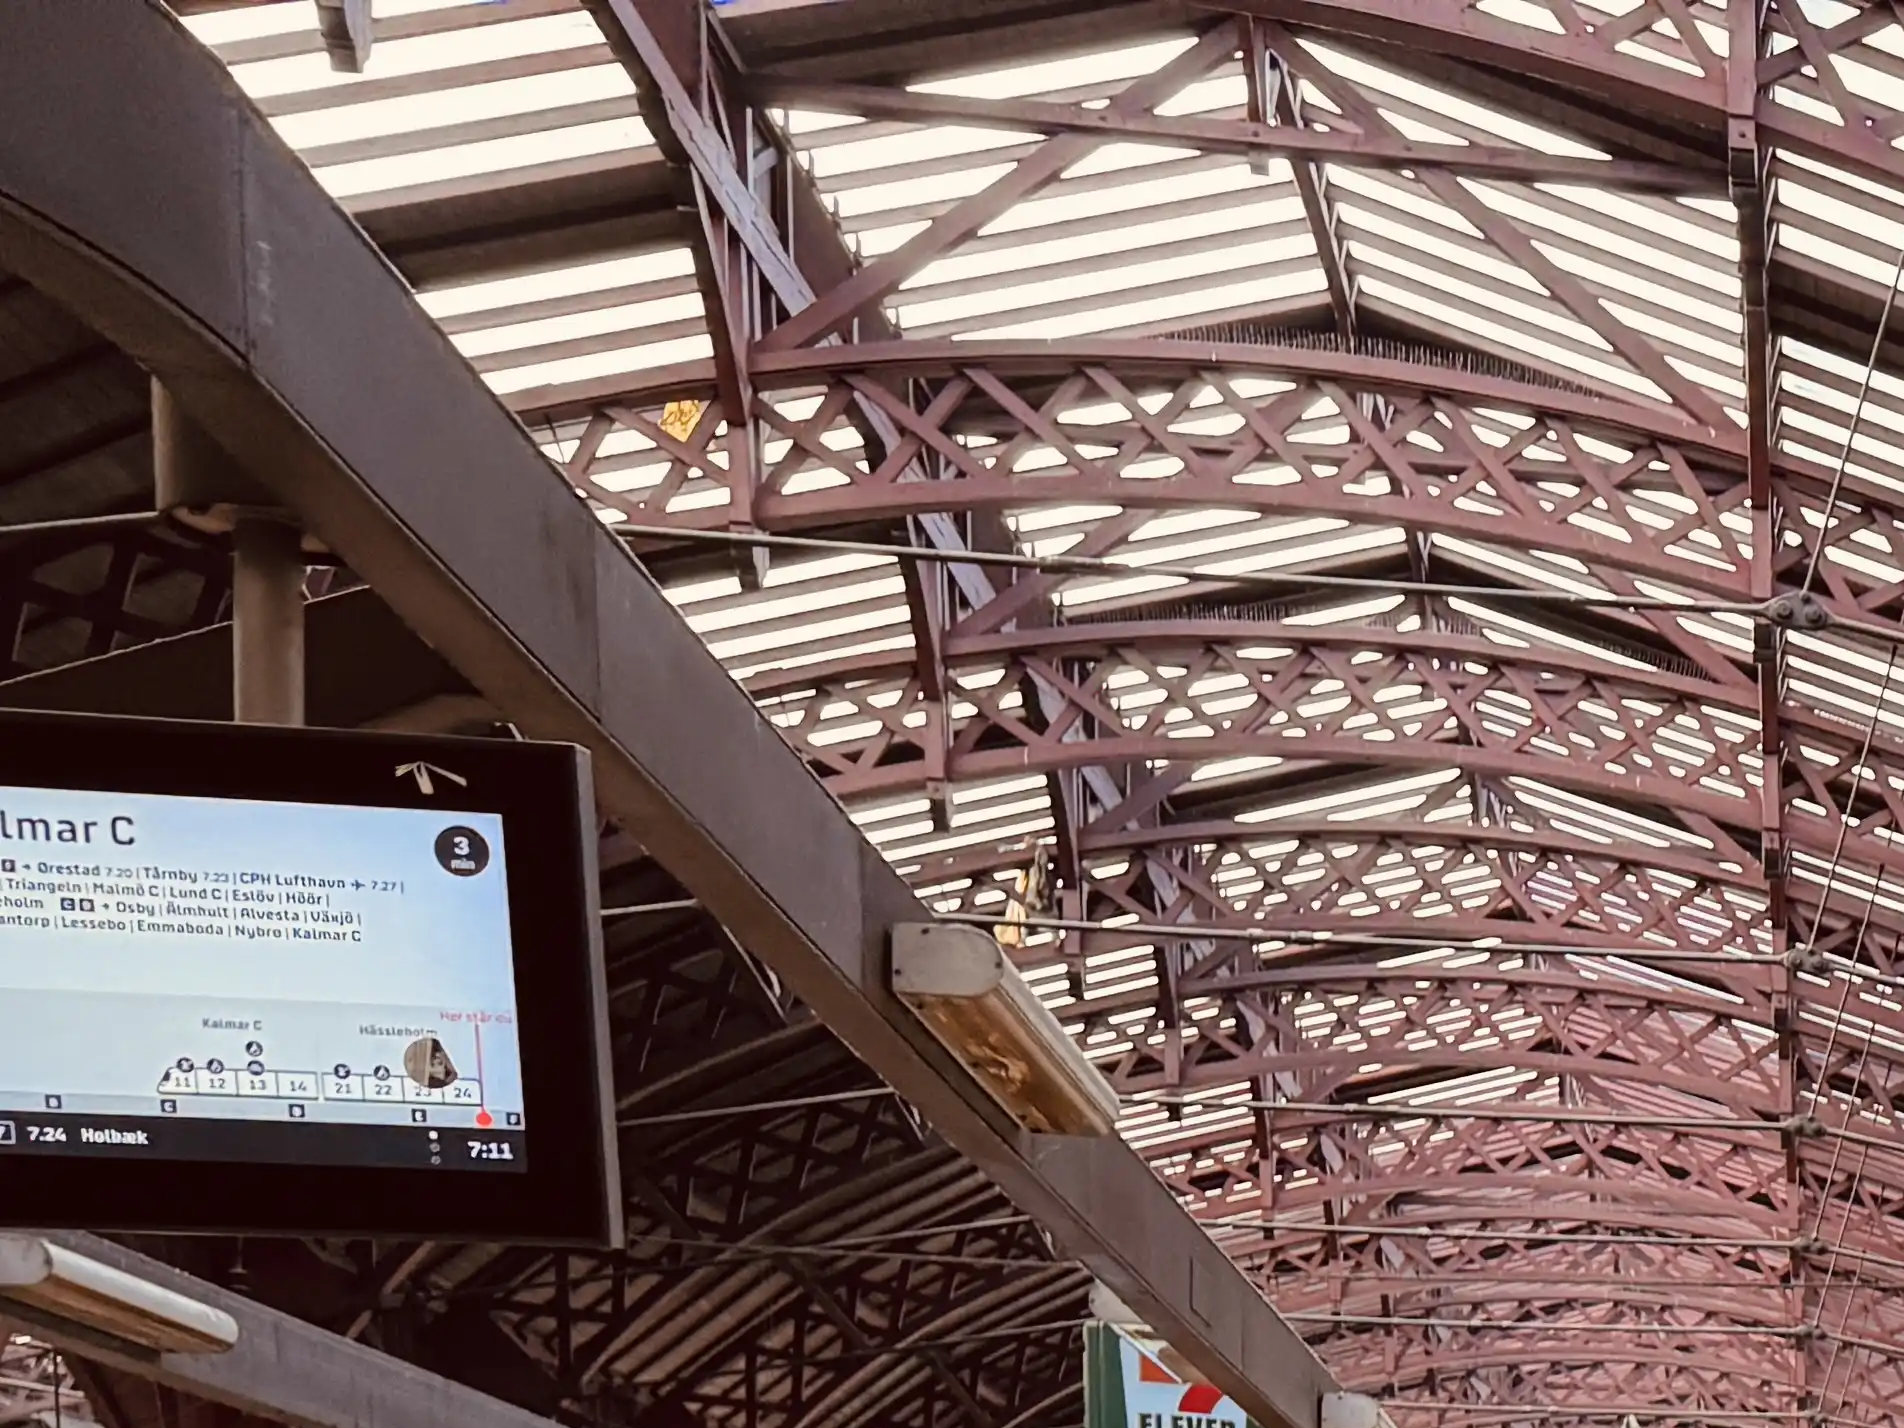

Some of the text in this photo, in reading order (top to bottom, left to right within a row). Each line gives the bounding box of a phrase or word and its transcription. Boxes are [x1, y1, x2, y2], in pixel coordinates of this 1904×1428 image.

[111, 816, 135, 846] C
[454, 836, 470, 856] 3
[143, 866, 198, 884] Tårnby
[240, 872, 271, 885] CPH
[275, 874, 345, 888] Lufthavn
[5, 878, 81, 893] Triangeln
[93, 882, 145, 896] Malmö
[148, 885, 159, 897] C
[170, 886, 207, 899] Lund
[211, 888, 221, 900] C
[232, 889, 274, 902] Eslöv
[116, 901, 155, 917] Osby
[241, 908, 299, 921] Alvesta
[61, 916, 126, 930] Lessebo
[137, 919, 224, 935] Emmaboda
[235, 924, 282, 940] Nybro
[293, 927, 347, 941] Kalmar
[352, 930, 361, 942] C
[202, 1018, 262, 1031] Kalmar C
[209, 1078, 225, 1089] 12
[26, 1126, 149, 1145] 7.24 Holbæk
[467, 1141, 514, 1160] 7:11
